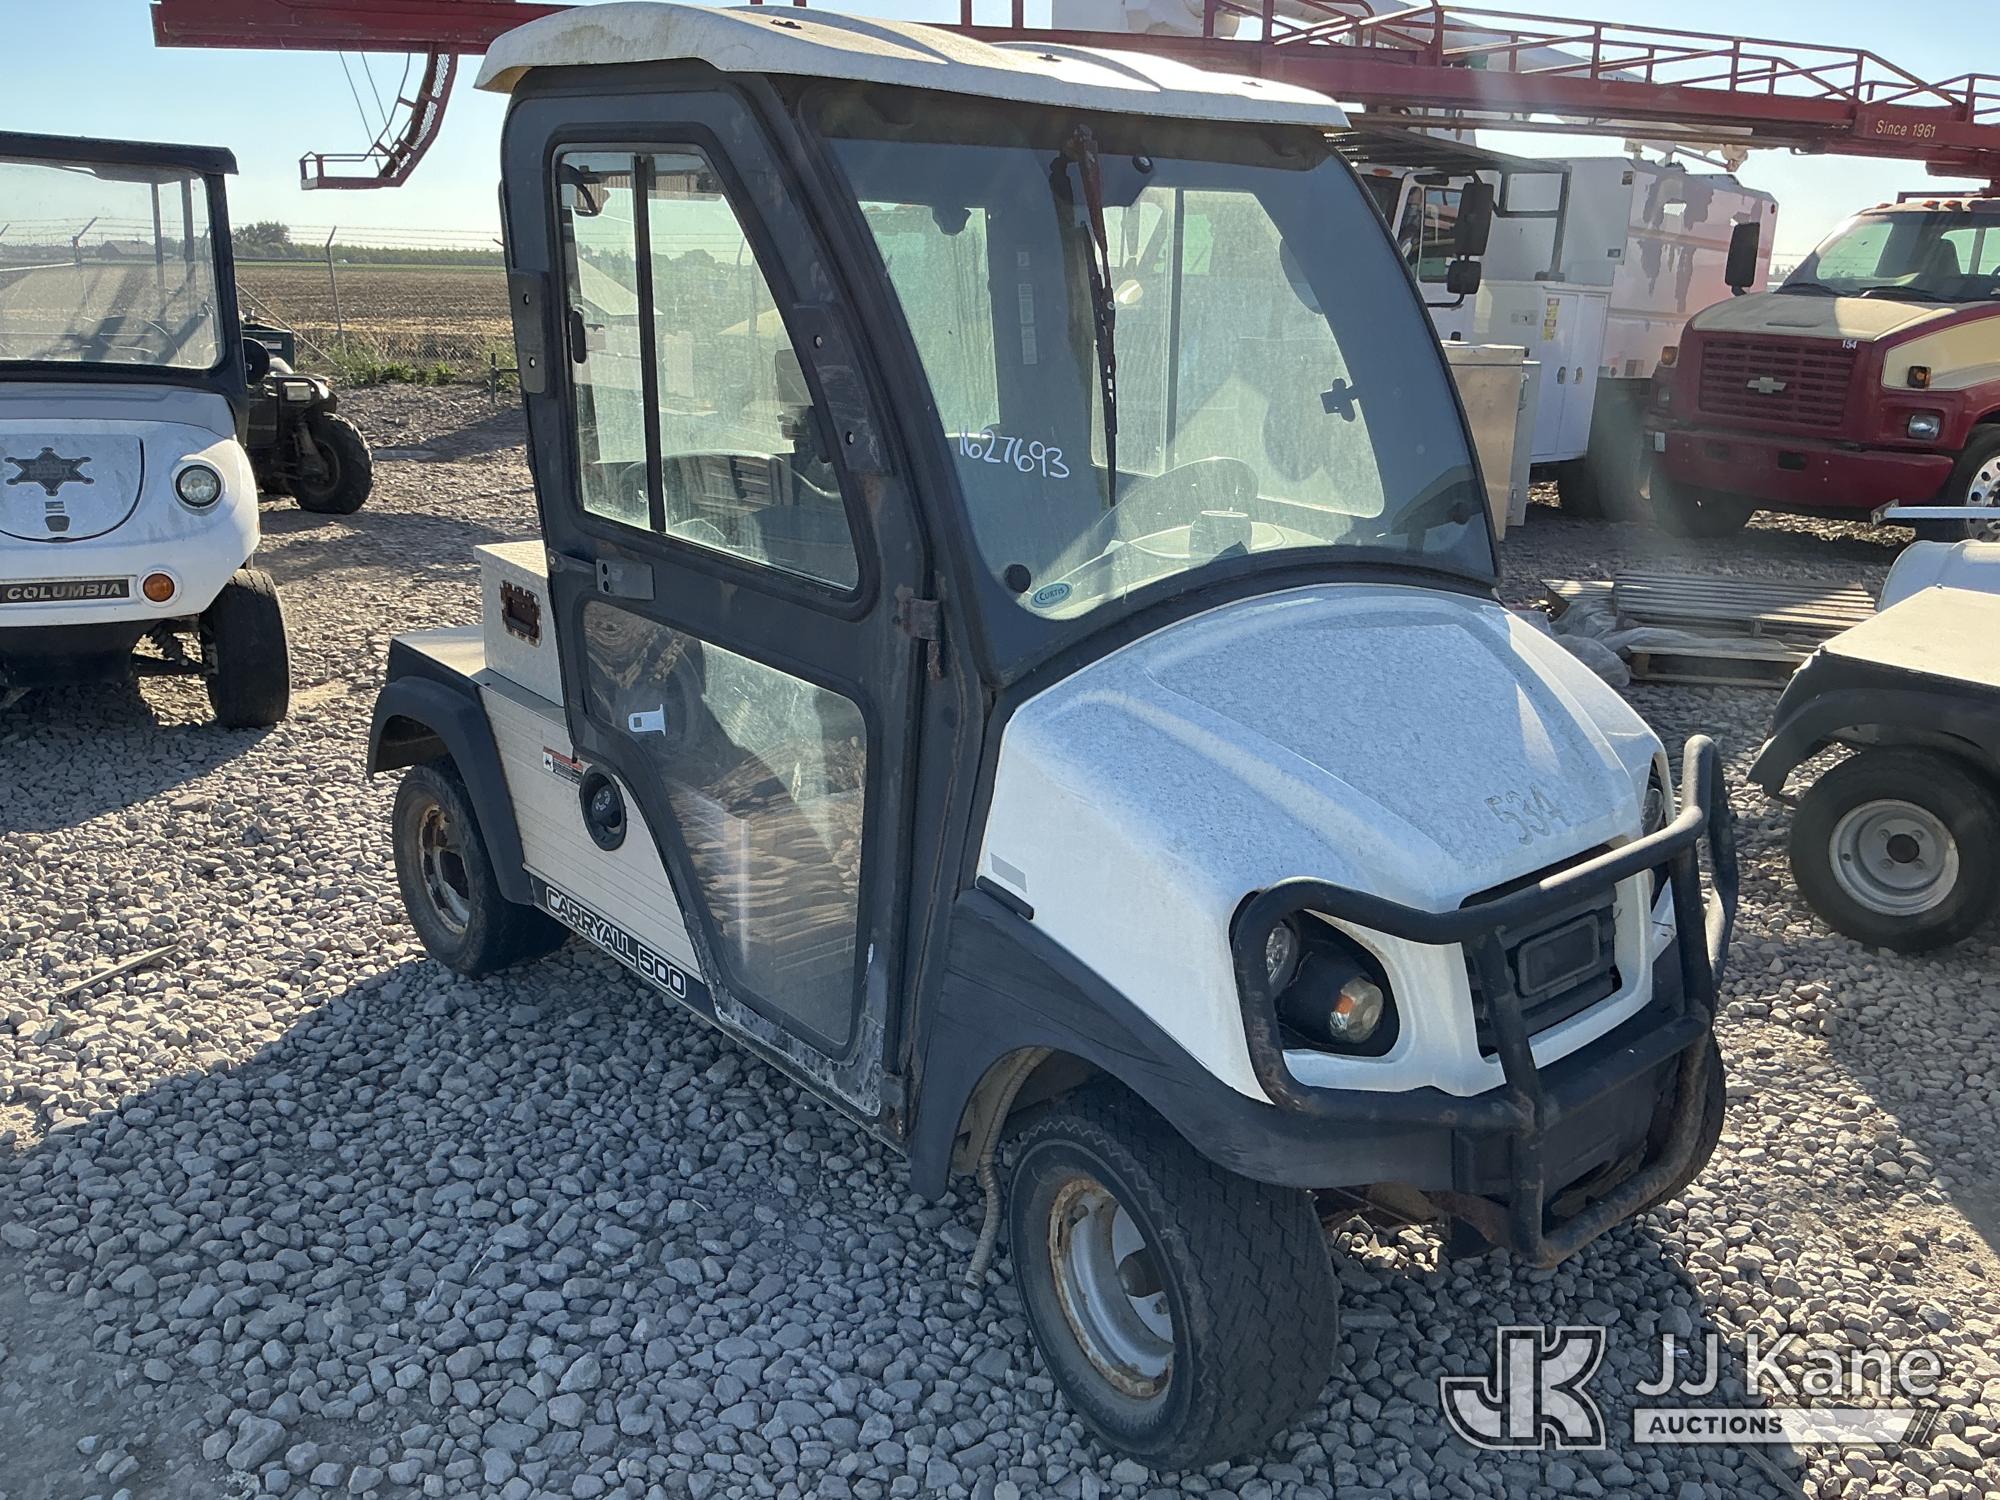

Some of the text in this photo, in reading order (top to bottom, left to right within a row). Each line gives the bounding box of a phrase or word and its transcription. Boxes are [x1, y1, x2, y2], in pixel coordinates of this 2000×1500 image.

[1876, 120, 1936, 138] Since 1961
[960, 428, 1070, 478] 1627693
[7, 583, 121, 600] COLUMBIA
[546, 886, 686, 999] CARRYALL 500
